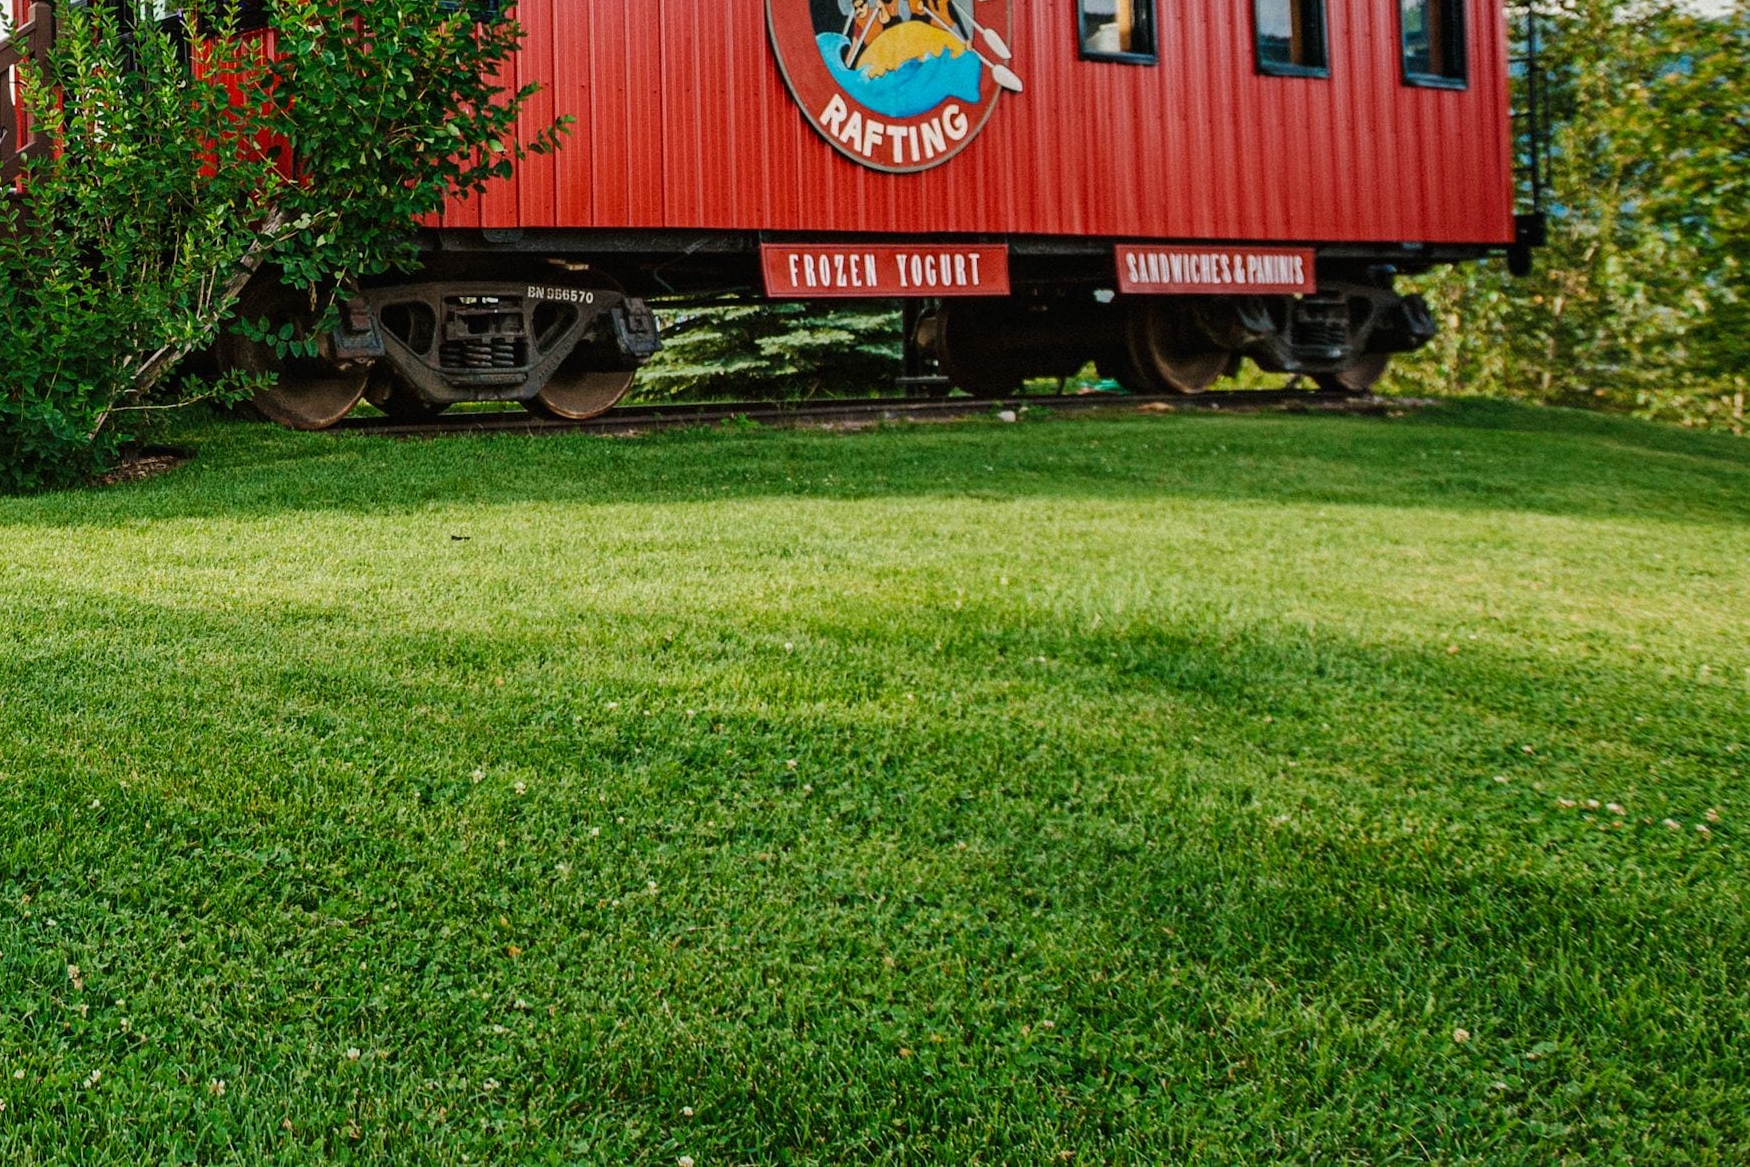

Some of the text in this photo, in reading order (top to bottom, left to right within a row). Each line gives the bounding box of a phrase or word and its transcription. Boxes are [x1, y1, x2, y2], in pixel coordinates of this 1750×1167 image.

[819, 93, 969, 163] RAFTING
[788, 252, 981, 288] FROZEN YOGURT
[1125, 252, 1232, 284] SANDWICHES
[1233, 254, 1246, 284] &
[528, 286, 545, 299] BN
